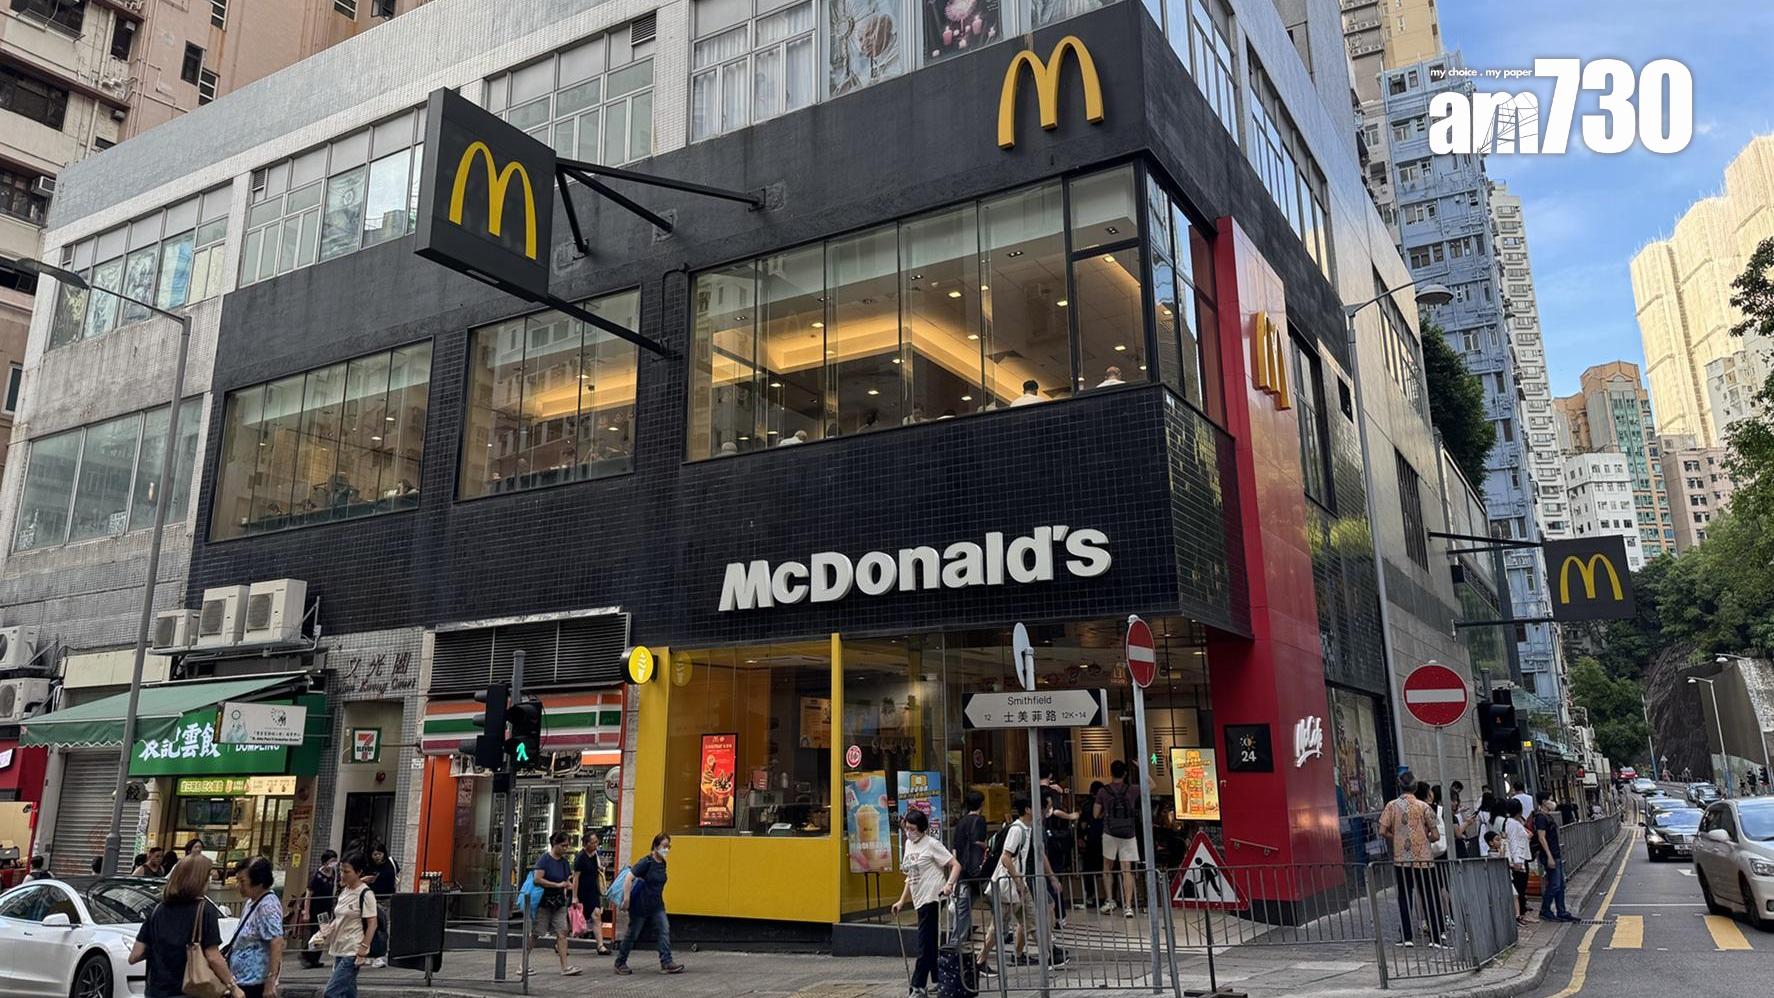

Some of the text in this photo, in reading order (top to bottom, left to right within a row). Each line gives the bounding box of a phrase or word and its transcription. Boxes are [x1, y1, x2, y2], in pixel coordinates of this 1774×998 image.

[718, 525, 1112, 612] McDonald's
[391, 677, 416, 689] Court
[1007, 696, 1052, 706] Smithfield
[1003, 710, 1057, 723] 士美菲路
[1241, 750, 1257, 762] 24
